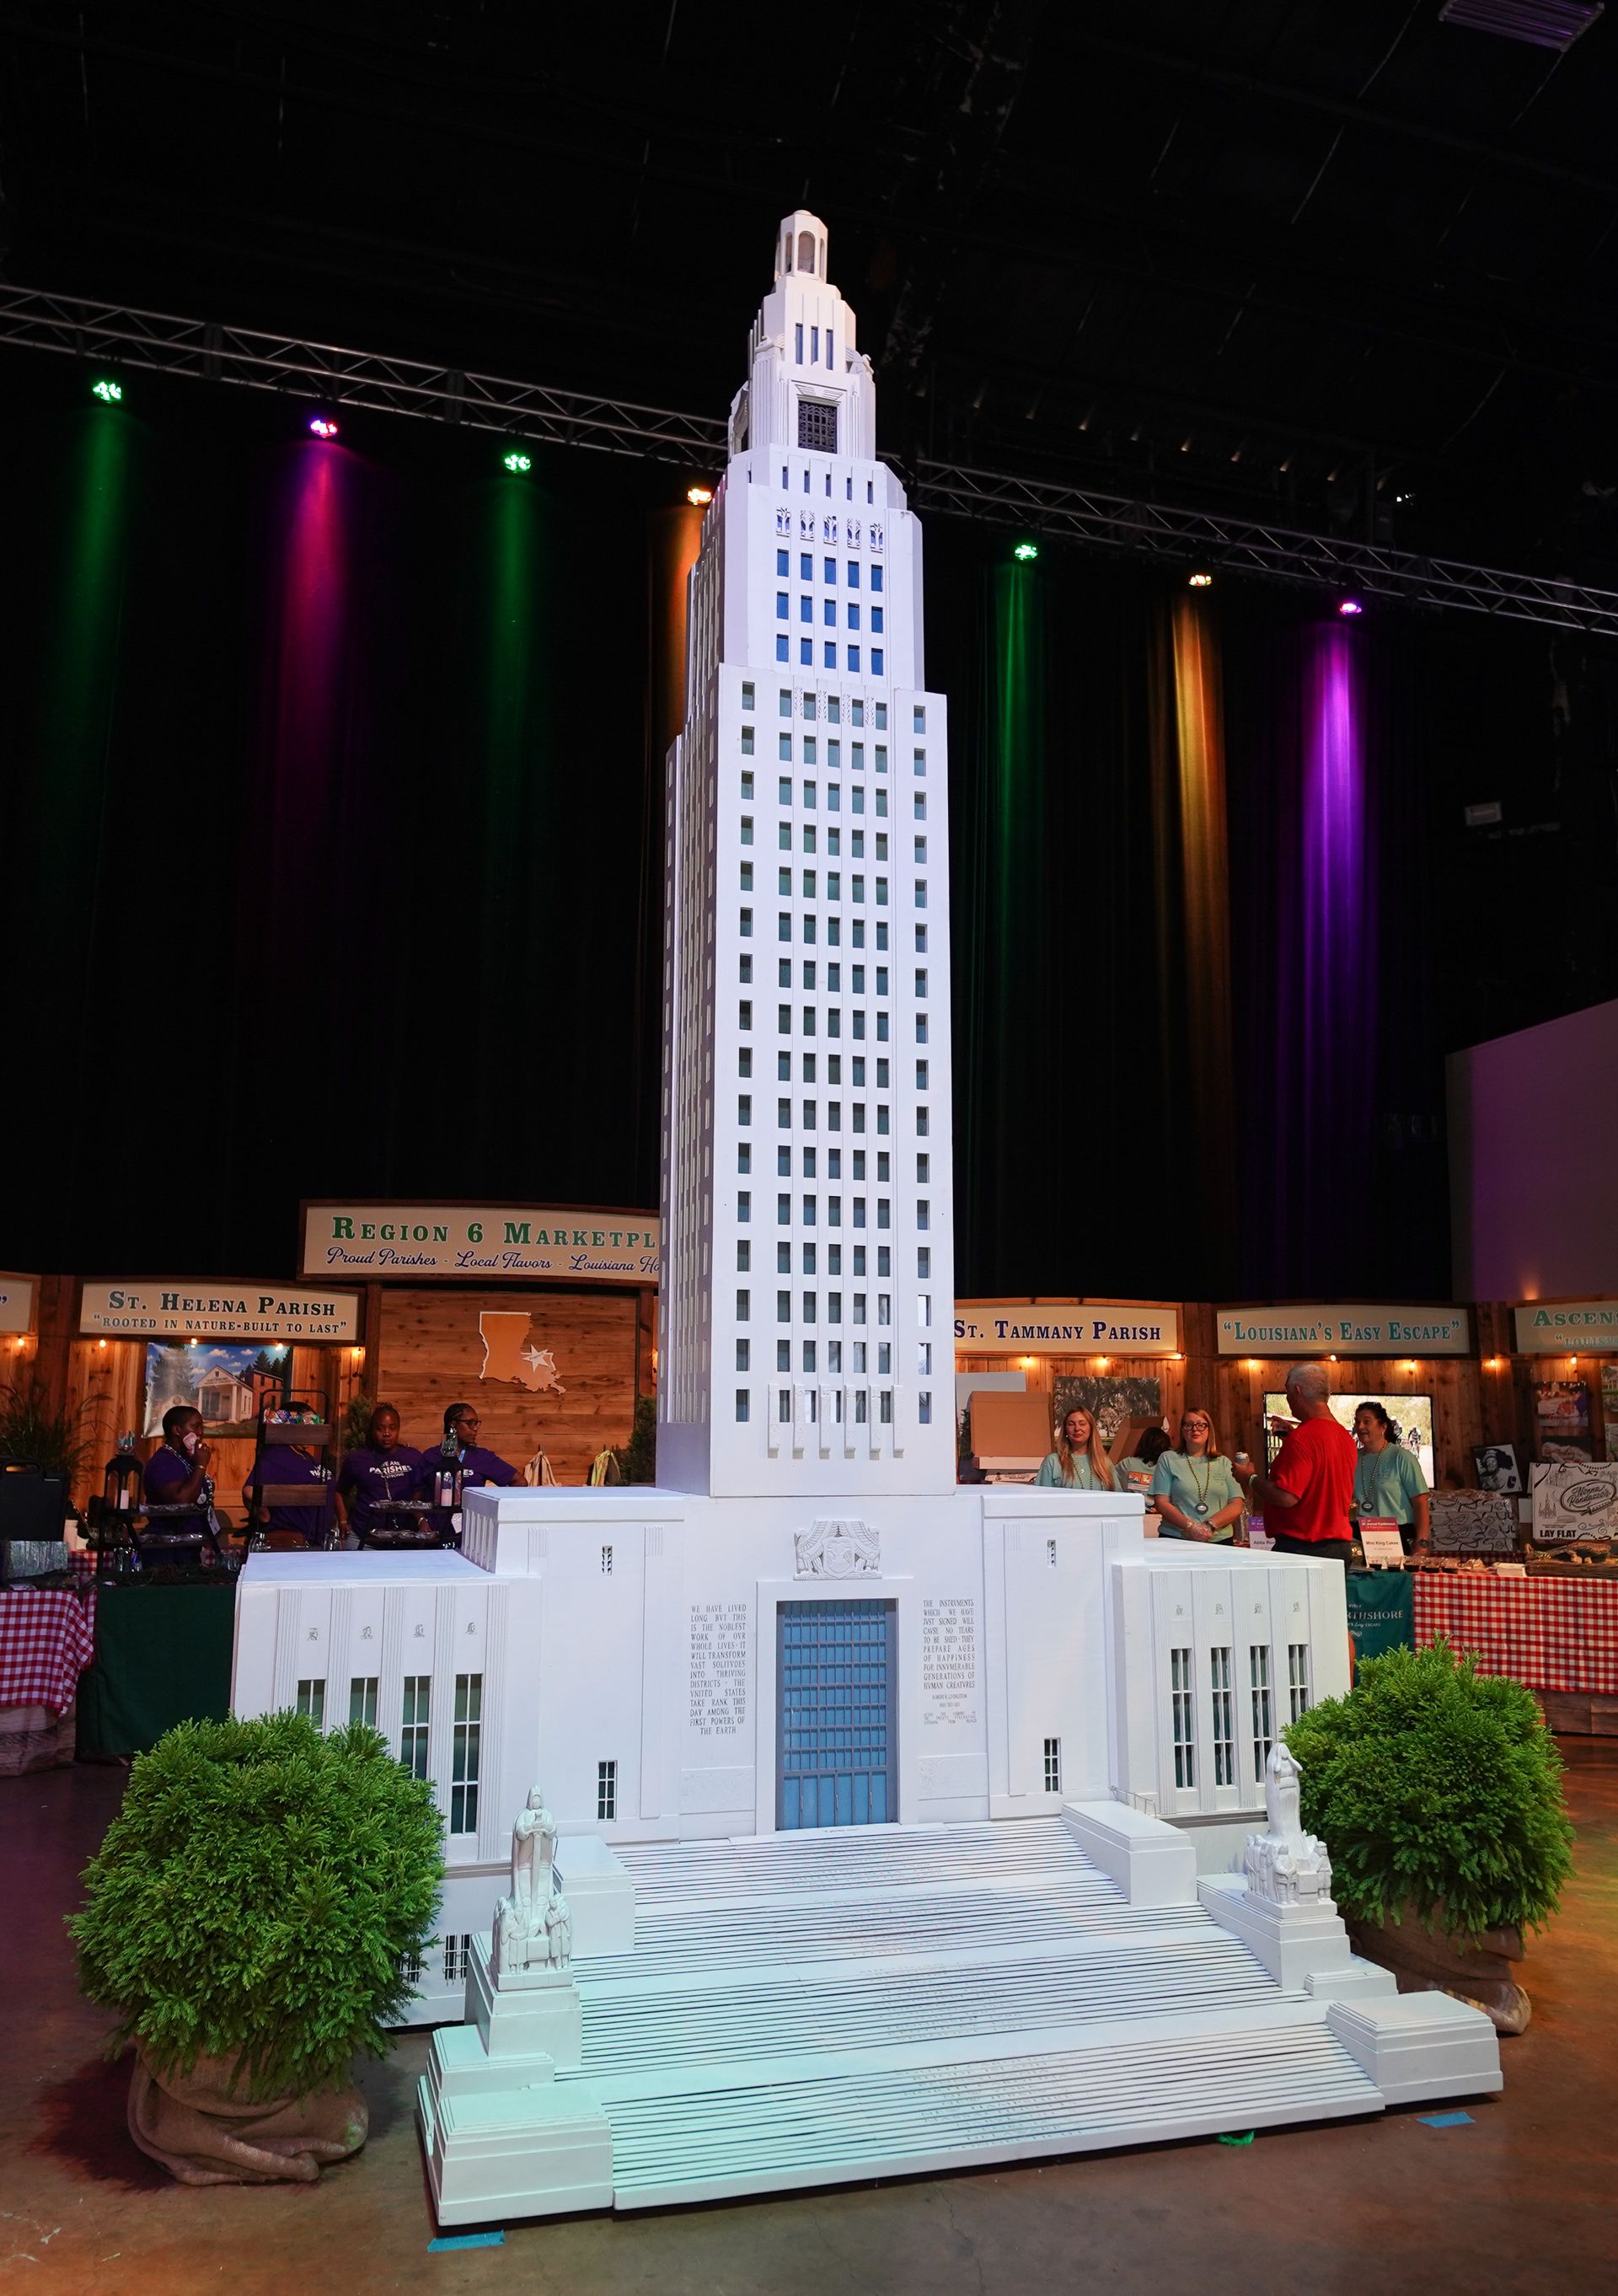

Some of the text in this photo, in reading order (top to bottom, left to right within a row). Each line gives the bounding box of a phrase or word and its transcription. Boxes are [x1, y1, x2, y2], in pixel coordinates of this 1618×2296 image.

[331, 1216, 656, 1248] REGION 6 MARKETPL
[326, 1247, 377, 1267] Proud
[378, 1248, 437, 1268] Parishes
[456, 1248, 498, 1269] Local
[501, 1249, 553, 1269] Flavors
[568, 1253, 635, 1271] Louisiana
[109, 1290, 336, 1317] ST. HELENA PARISH
[93, 1313, 347, 1334] “ROOTED IN NATURE-BUILT TO LAST”
[954, 1319, 1160, 1340] ST. TAMMANY PARISH
[1339, 1322, 1381, 1340] EASY
[1388, 1321, 1460, 1340] ESCAPE”
[369, 1465, 412, 1473] PARISHES
[719, 1623, 746, 1631] NOBLEST
[691, 1633, 709, 1641] WORK
[691, 1642, 712, 1650] WHOLE
[708, 1650, 746, 1659] TRANSFORM
[691, 1671, 705, 1679] INTO
[924, 1672, 964, 1681] GENERATIONS
[690, 1709, 702, 1717] DAY
[690, 1718, 706, 1726] FIRST
[737, 1716, 745, 1725] OF
[716, 1726, 736, 1735] EARTH
